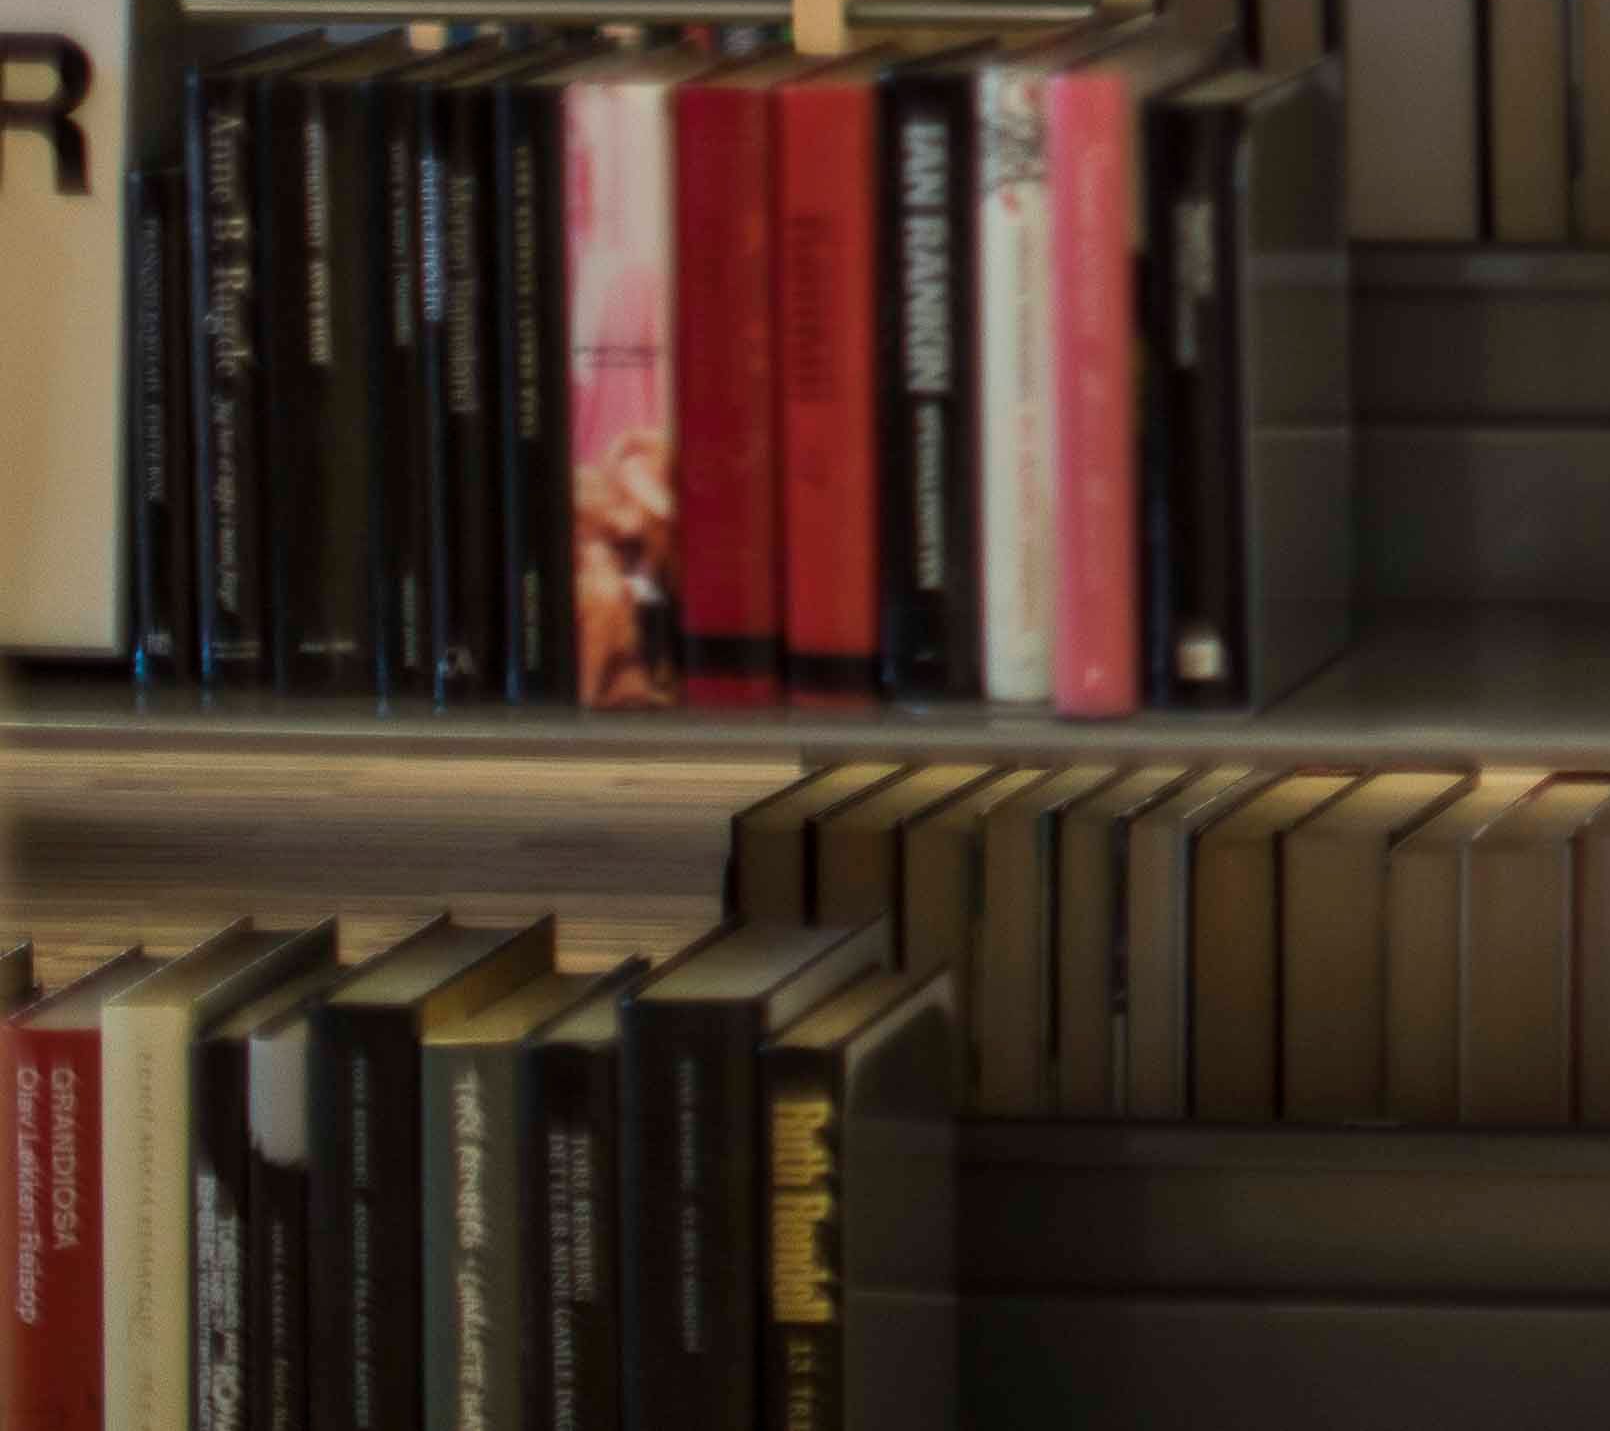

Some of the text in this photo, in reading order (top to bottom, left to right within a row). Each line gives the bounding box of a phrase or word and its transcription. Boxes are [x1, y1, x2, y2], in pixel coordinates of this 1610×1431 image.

[0, 31, 92, 198] R
[208, 114, 245, 203] Anne
[902, 122, 949, 206] IAN
[209, 217, 248, 250] B.
[203, 266, 250, 377] Ragde
[903, 216, 949, 392] RANKIN
[51, 1067, 79, 1251] GRANDIOSA
[572, 1133, 593, 1303] TORE RENBERG
[773, 1191, 834, 1323] Rendell
[551, 1307, 573, 1383] GAMLE
